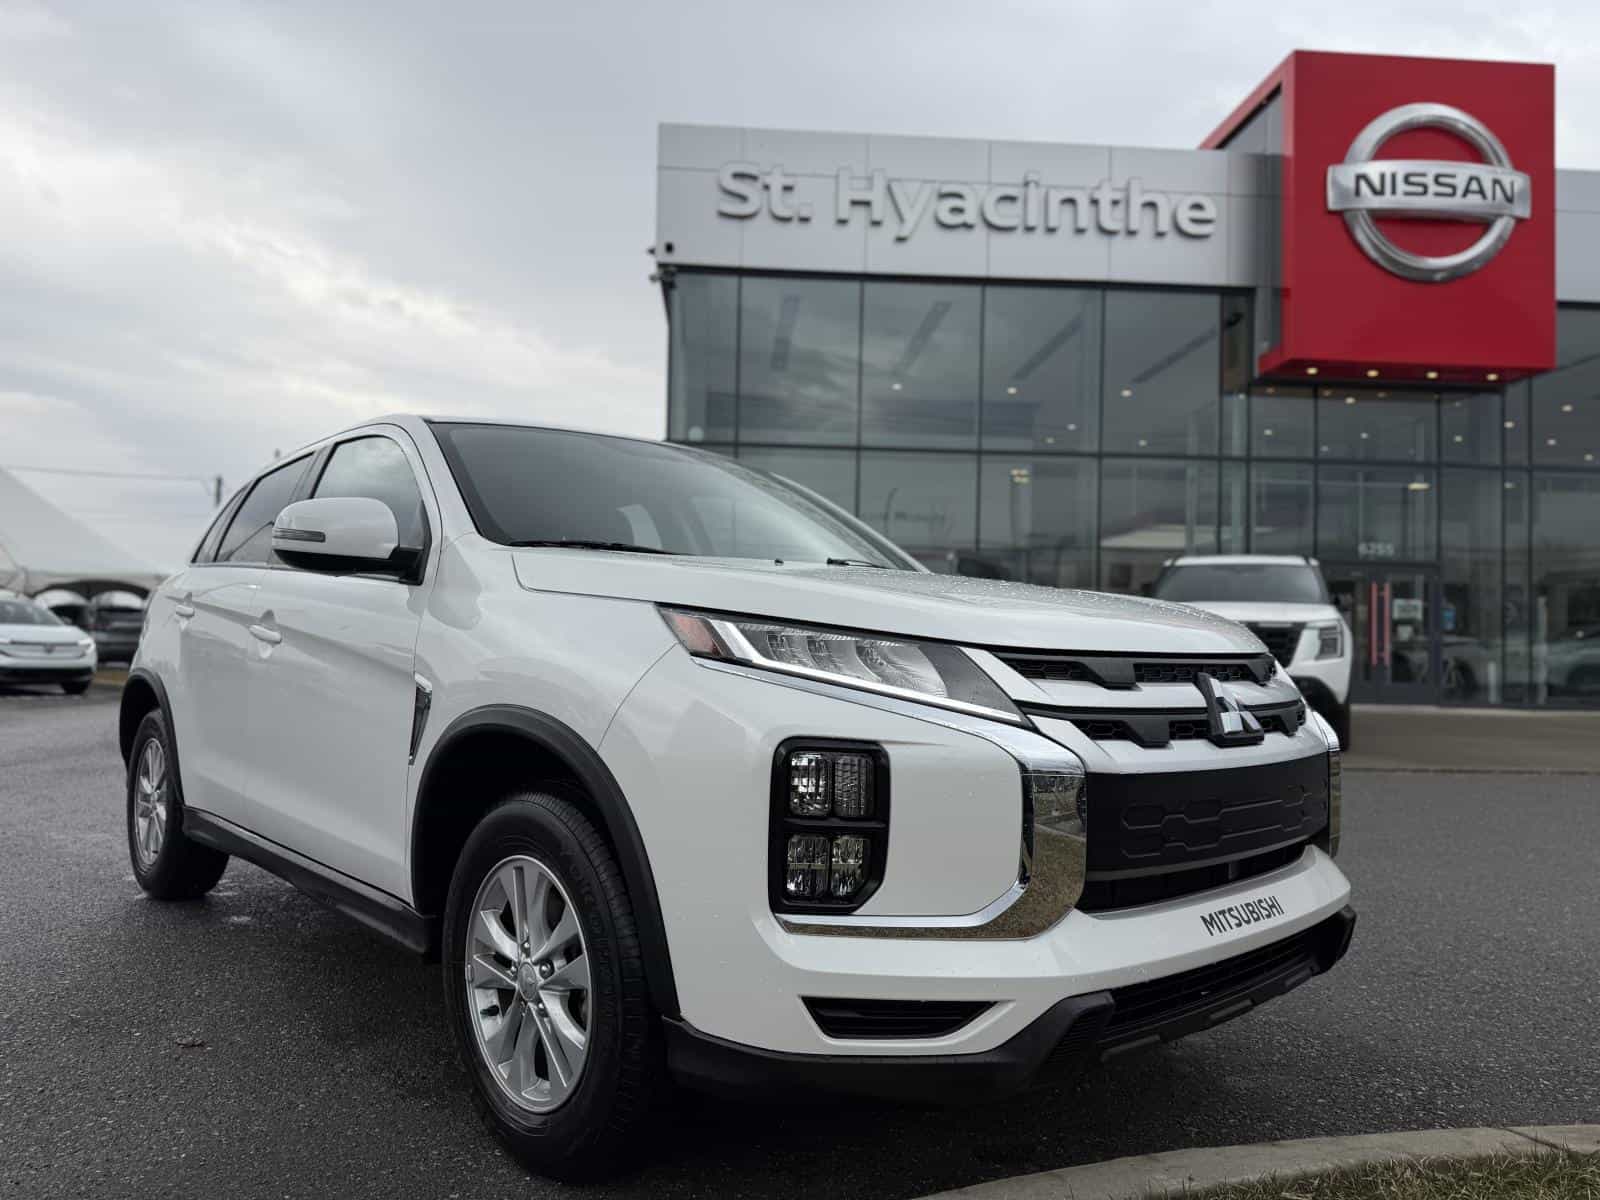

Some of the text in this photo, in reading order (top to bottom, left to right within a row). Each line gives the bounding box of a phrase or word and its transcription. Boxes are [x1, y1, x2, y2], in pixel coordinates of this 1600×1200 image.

[717, 161, 1217, 242] St. Hyacinthe
[1354, 172, 1515, 204] NISSAN
[1200, 895, 1285, 936] MITSUBISHI
